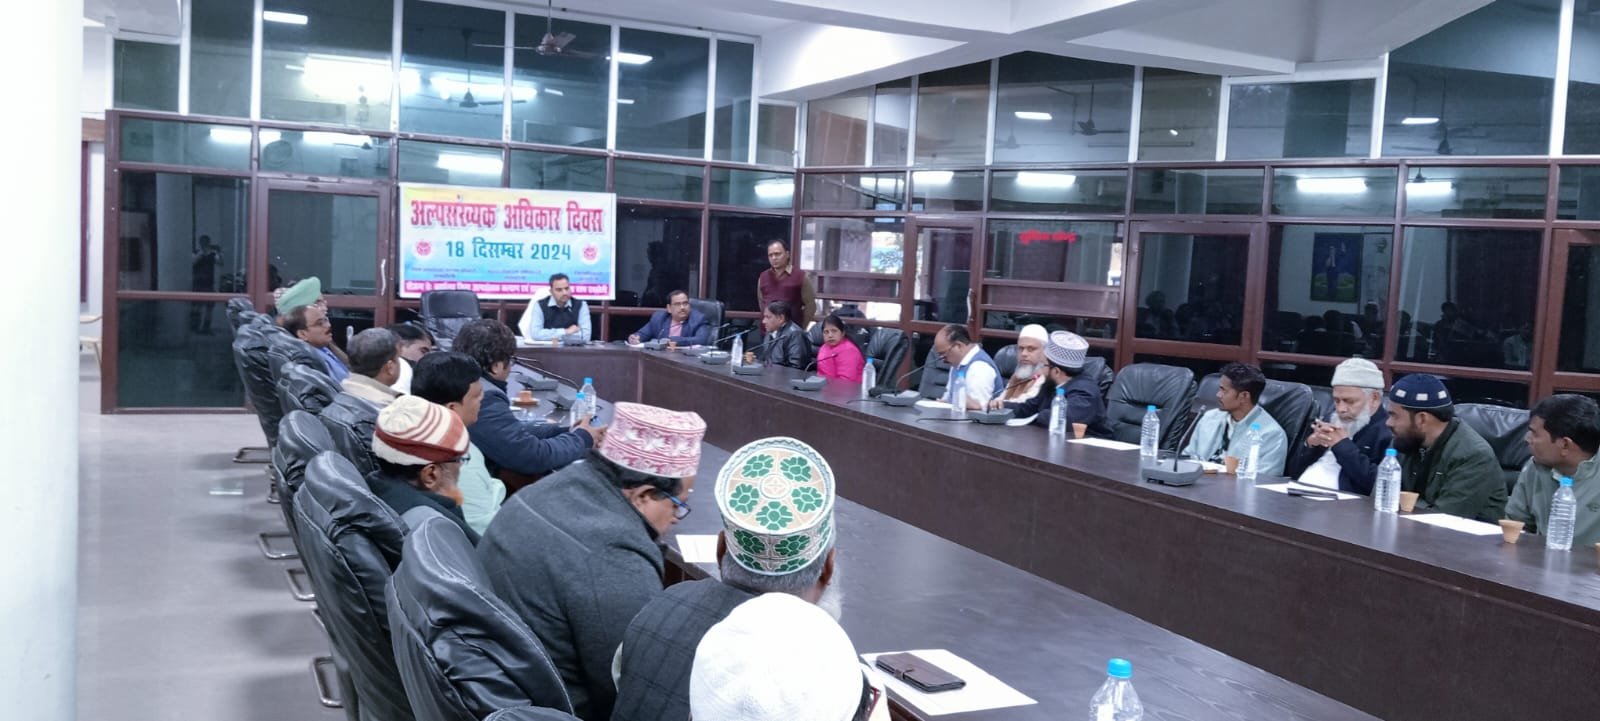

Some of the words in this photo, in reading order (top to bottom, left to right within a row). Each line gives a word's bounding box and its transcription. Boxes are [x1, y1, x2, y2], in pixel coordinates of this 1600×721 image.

[411, 199, 497, 226] अल्पसंख्यक
[504, 198, 561, 230] अधिकार
[567, 201, 604, 232] दिवस
[446, 240, 464, 258] 18
[472, 237, 525, 259] दिसम्बर
[531, 244, 571, 260] 2024
